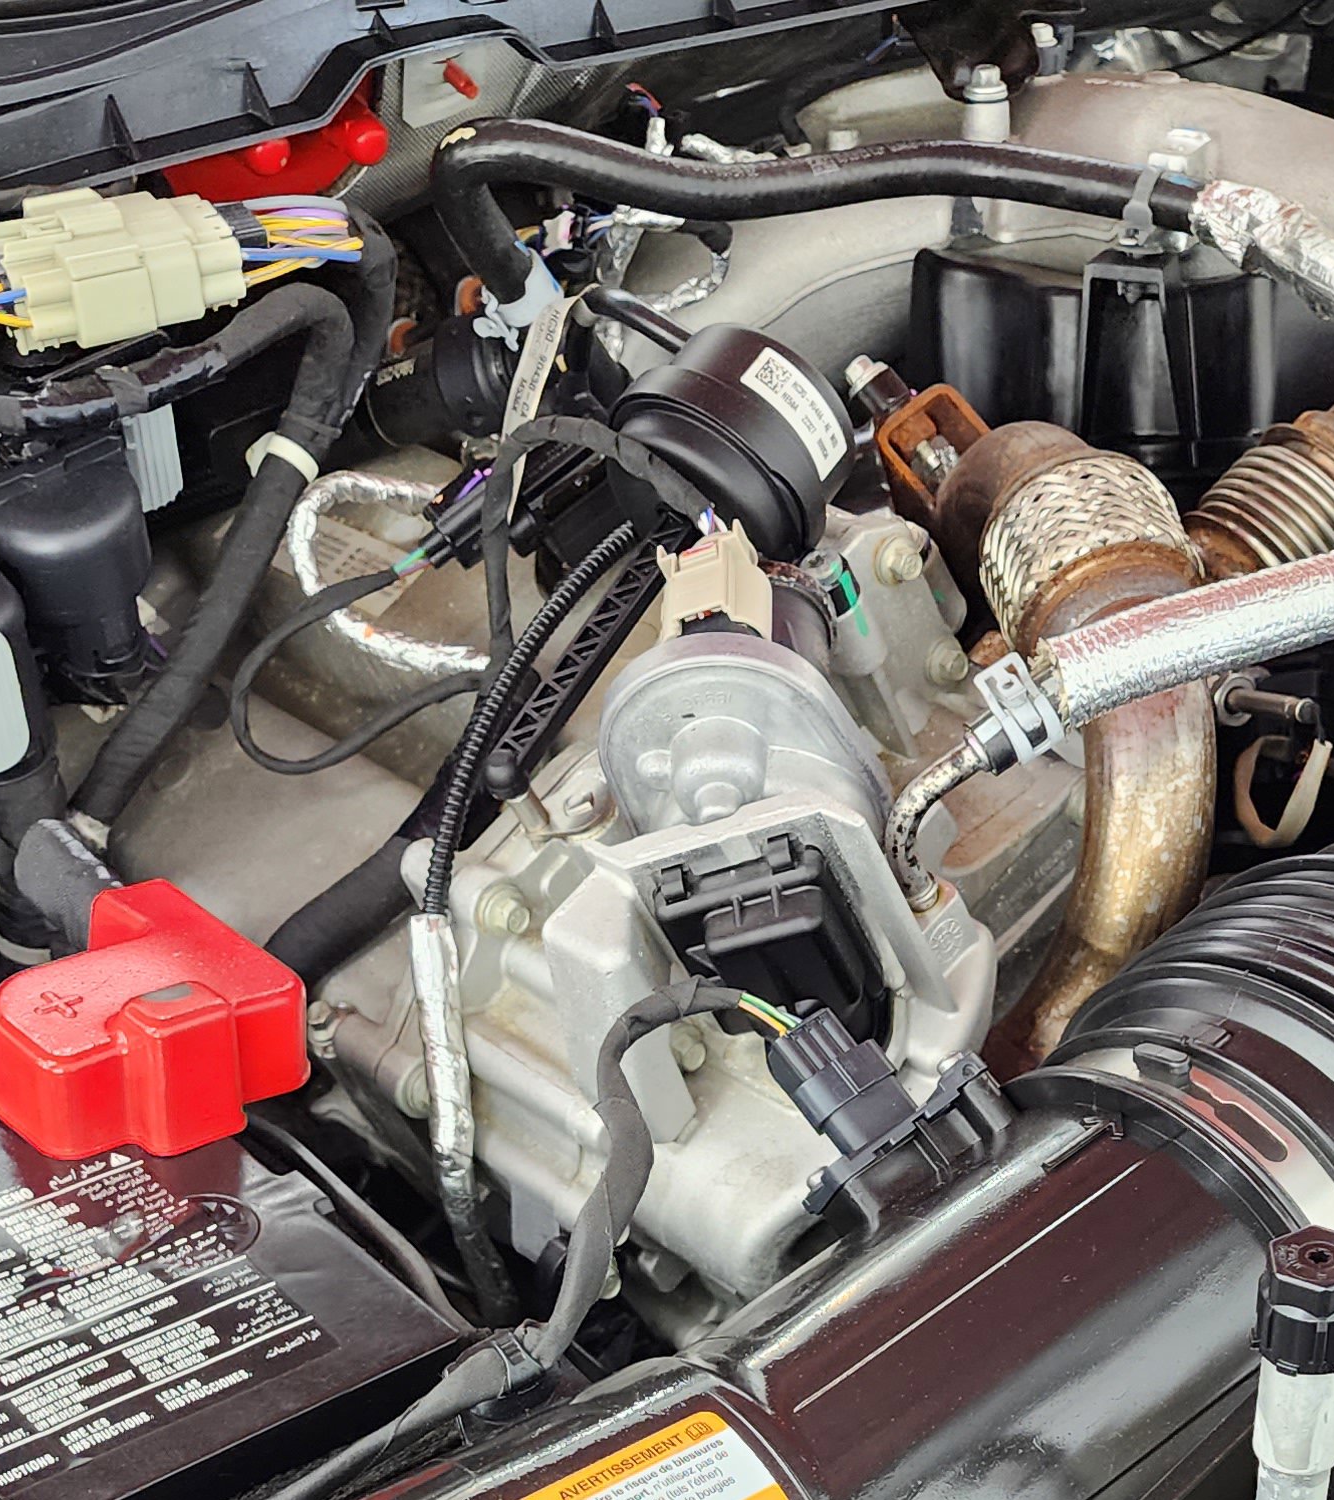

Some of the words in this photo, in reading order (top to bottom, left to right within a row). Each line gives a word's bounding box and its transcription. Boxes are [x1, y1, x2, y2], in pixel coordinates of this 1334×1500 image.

[610, 1488, 625, 1498] le
[623, 1470, 659, 1492] risque
[658, 1463, 674, 1474] de
[671, 1439, 724, 1468] blessures
[694, 1457, 715, 1473] pas
[714, 1450, 729, 1461] de
[694, 1476, 736, 1500] bougies
